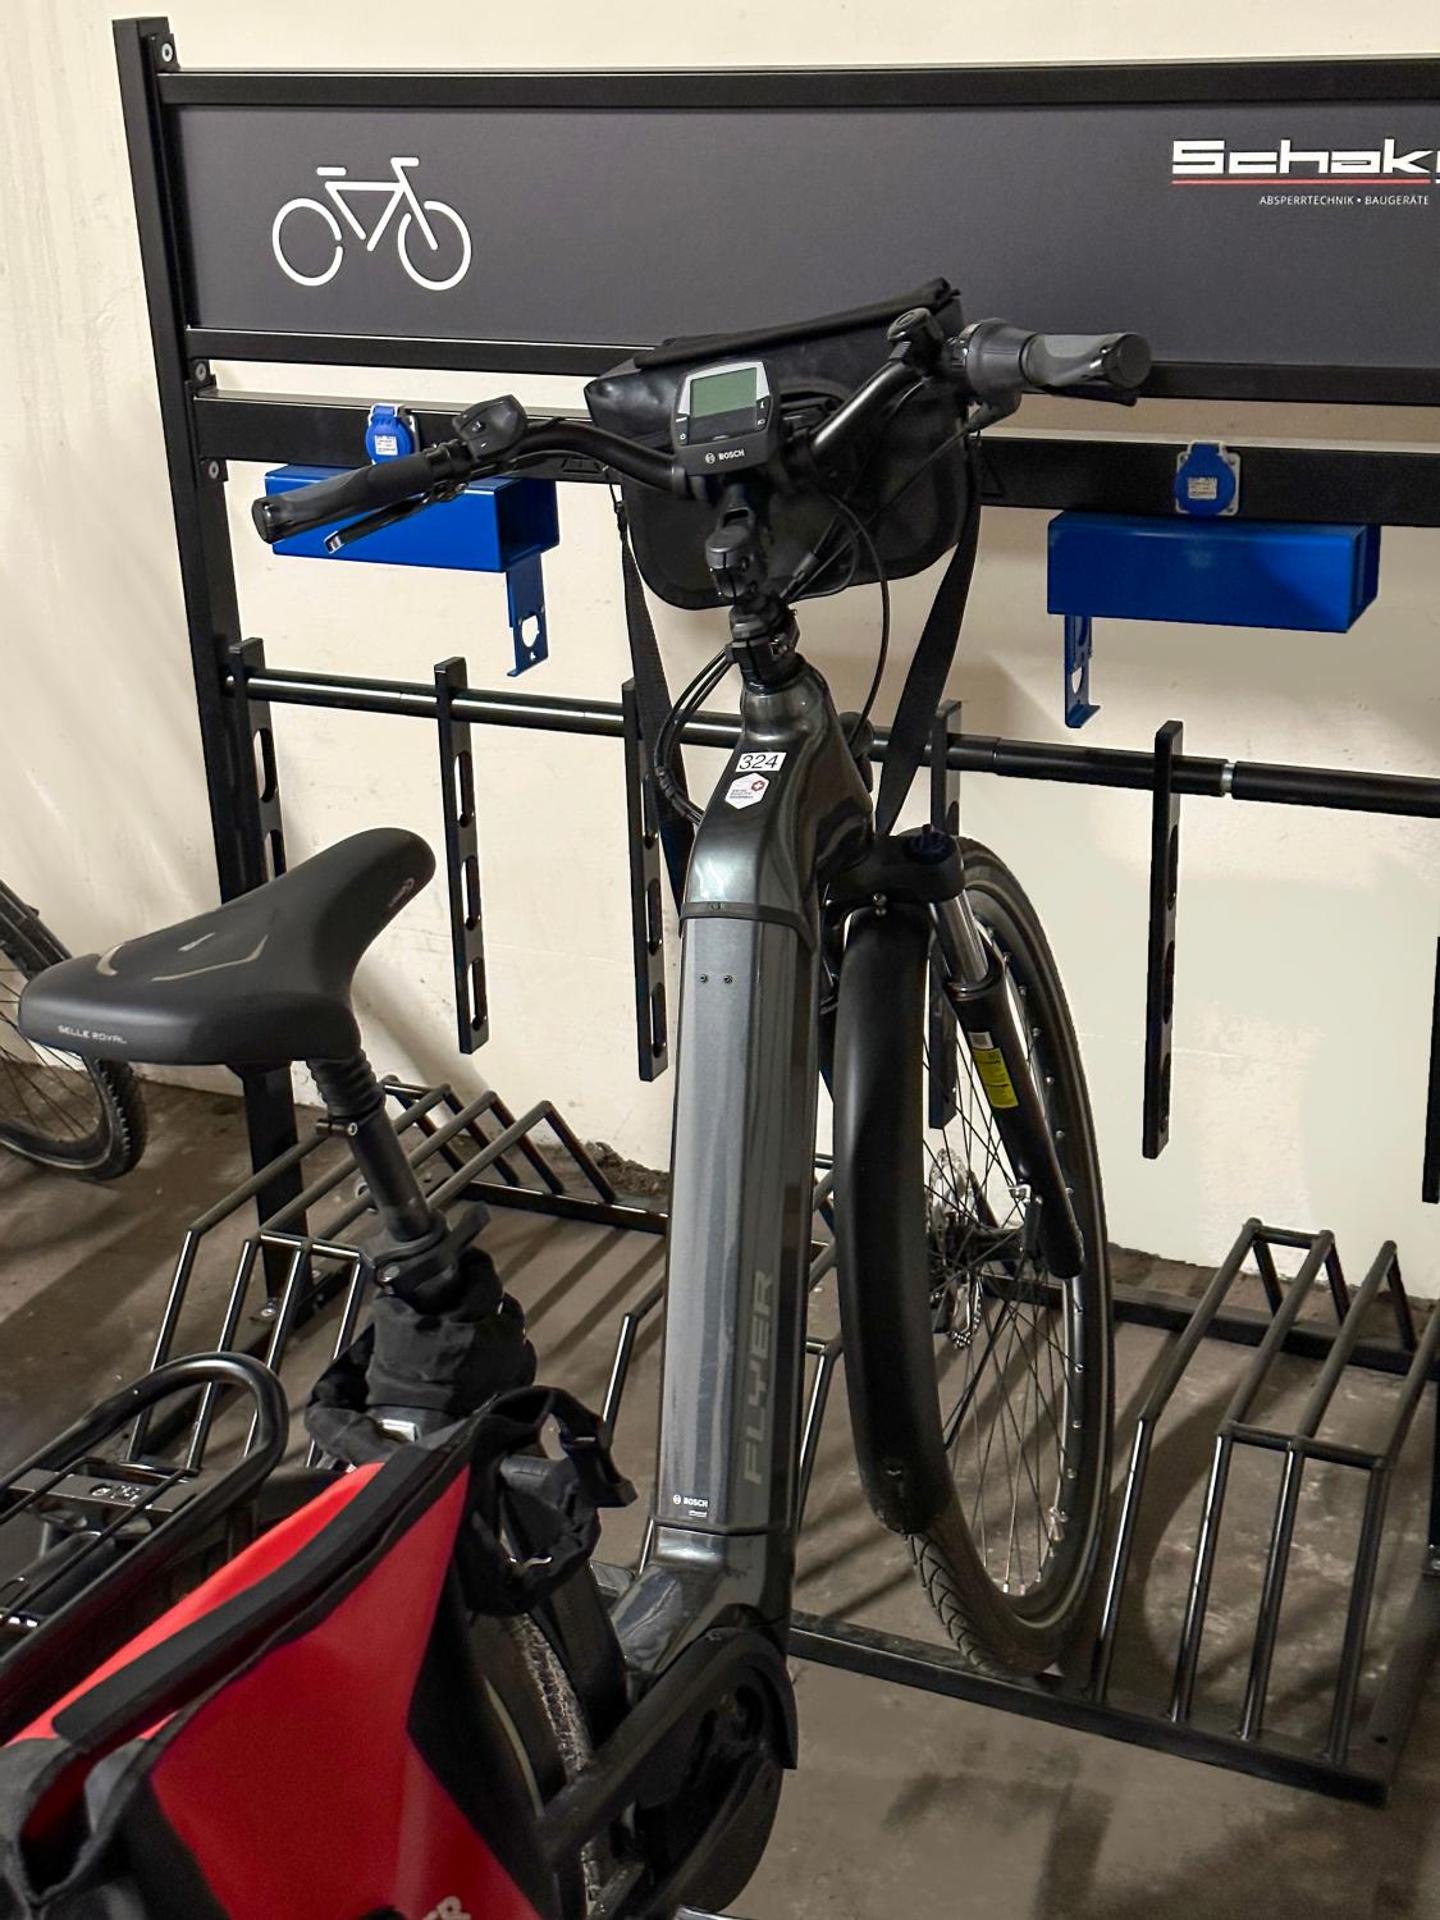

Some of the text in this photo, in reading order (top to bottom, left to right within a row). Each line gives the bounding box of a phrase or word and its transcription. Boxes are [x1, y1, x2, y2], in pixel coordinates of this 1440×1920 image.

[1172, 138, 1440, 184] Schak
[1259, 195, 1354, 206] ABSPERRTECHNIK
[718, 448, 745, 460] BOSCH
[739, 754, 779, 770] 324
[58, 1025, 128, 1044] SELLE ROYAL
[744, 1270, 773, 1484] FLYER
[683, 1496, 709, 1508] BOSCH
